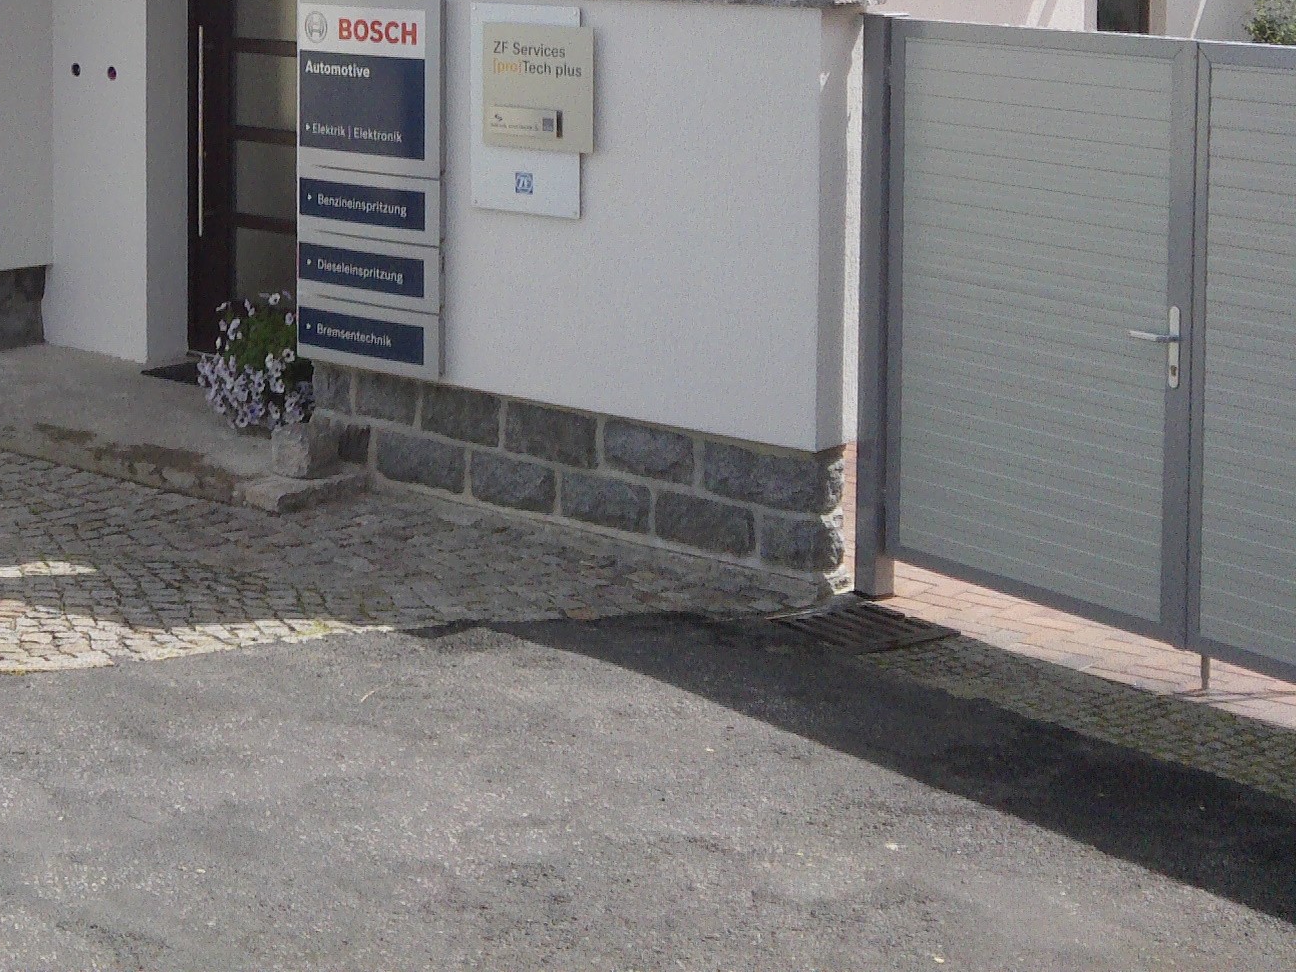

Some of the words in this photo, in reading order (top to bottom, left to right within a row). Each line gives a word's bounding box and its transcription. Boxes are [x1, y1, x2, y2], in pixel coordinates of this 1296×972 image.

[338, 17, 418, 46] BOSCH
[493, 40, 508, 54] ZF
[513, 41, 566, 59] Services
[305, 60, 371, 78] Automotive
[555, 64, 582, 78] plus
[312, 122, 345, 137] Elektrik
[354, 126, 403, 143] Elektronik
[317, 193, 407, 217] Benzineinspritzung
[317, 258, 404, 284] Dieseleinspritzung
[316, 322, 392, 347] Bremsentechnik
